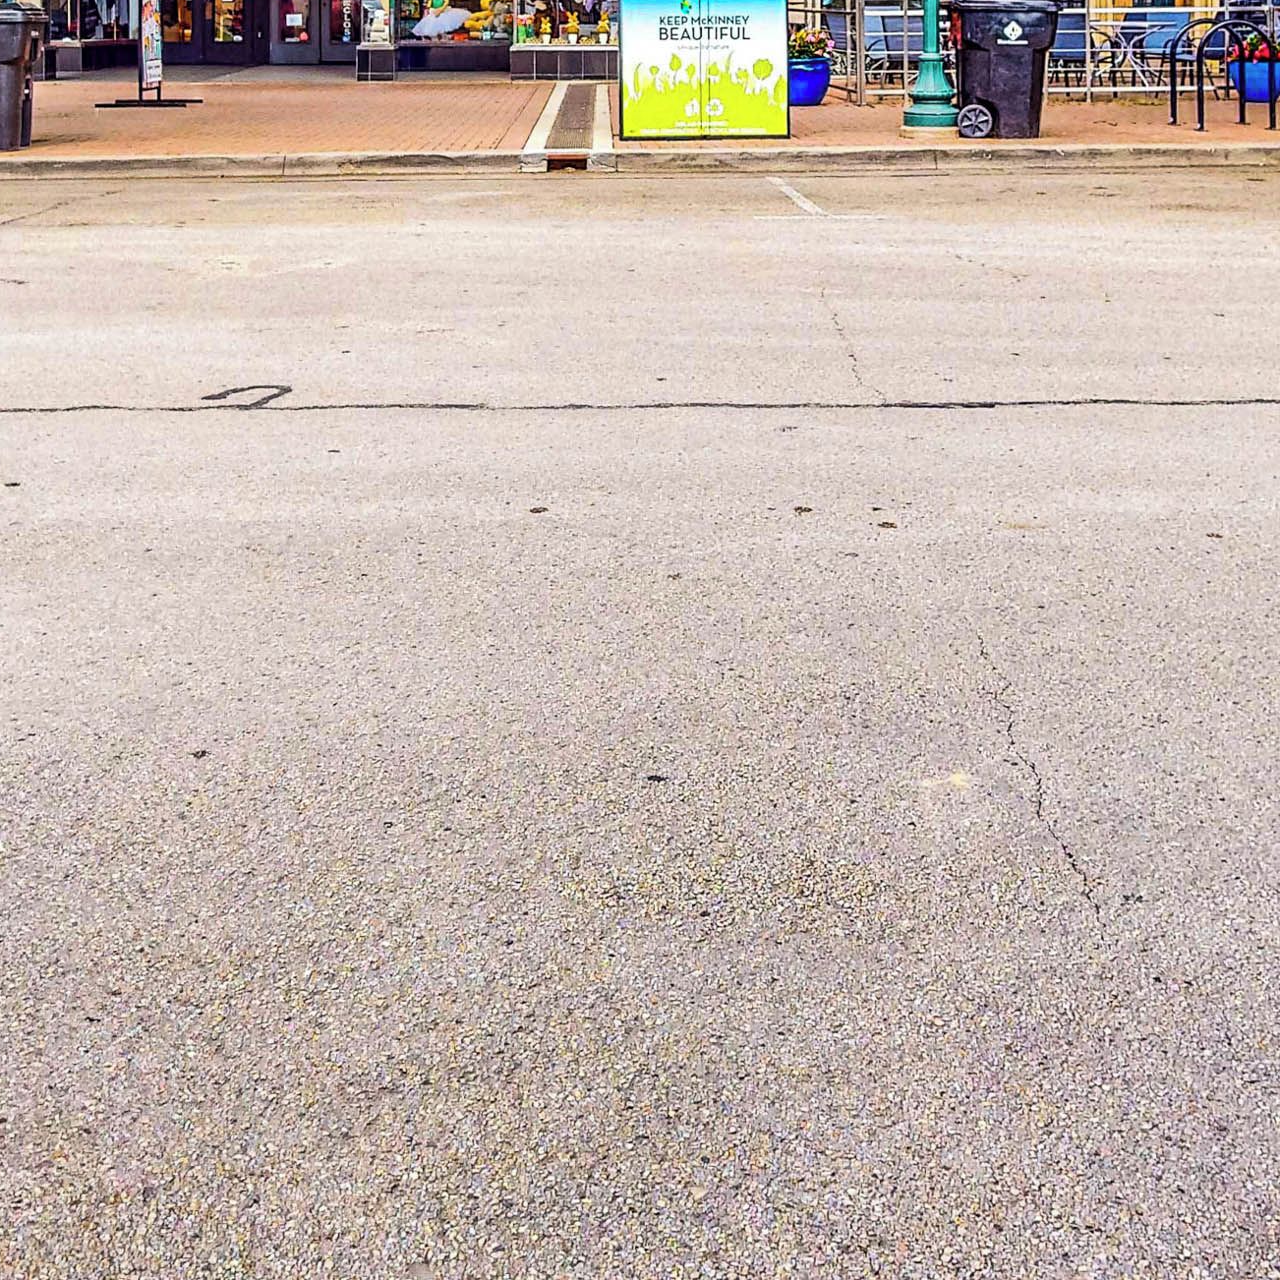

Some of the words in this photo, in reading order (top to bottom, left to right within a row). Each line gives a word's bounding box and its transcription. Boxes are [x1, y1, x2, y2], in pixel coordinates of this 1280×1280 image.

[659, 16, 689, 26] KEEP
[691, 15, 750, 26] McKINNEY
[658, 26, 751, 41] BEAUTIFUL
